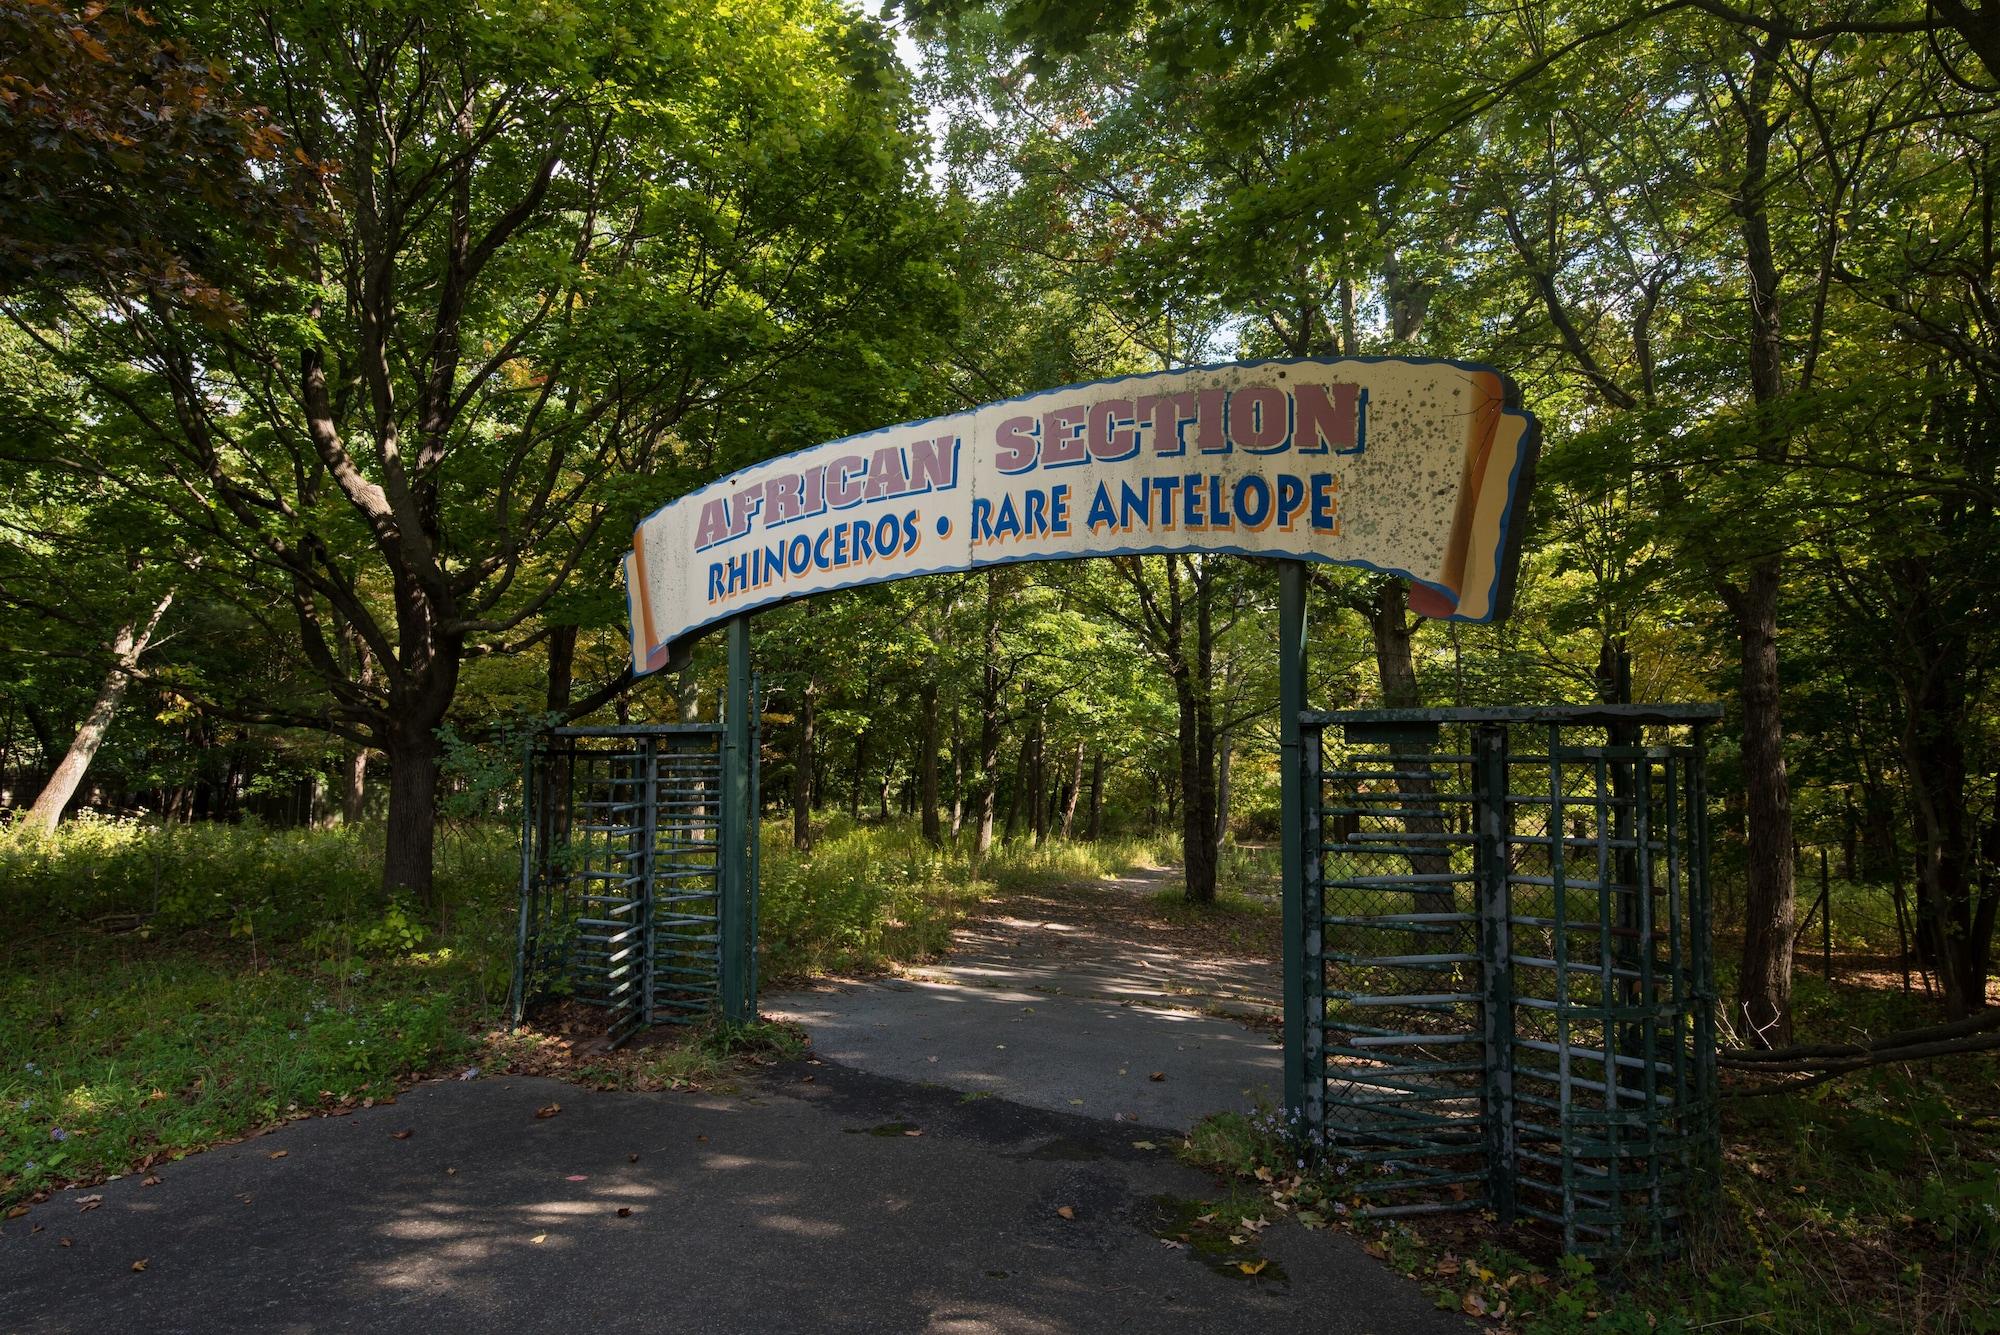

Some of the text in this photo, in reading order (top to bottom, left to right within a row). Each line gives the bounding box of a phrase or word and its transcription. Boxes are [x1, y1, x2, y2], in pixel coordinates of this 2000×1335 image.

[694, 383, 1369, 553] AFRICAN SECTION
[708, 473, 1341, 605] RHINOCEROS RARE ANTELOPE
